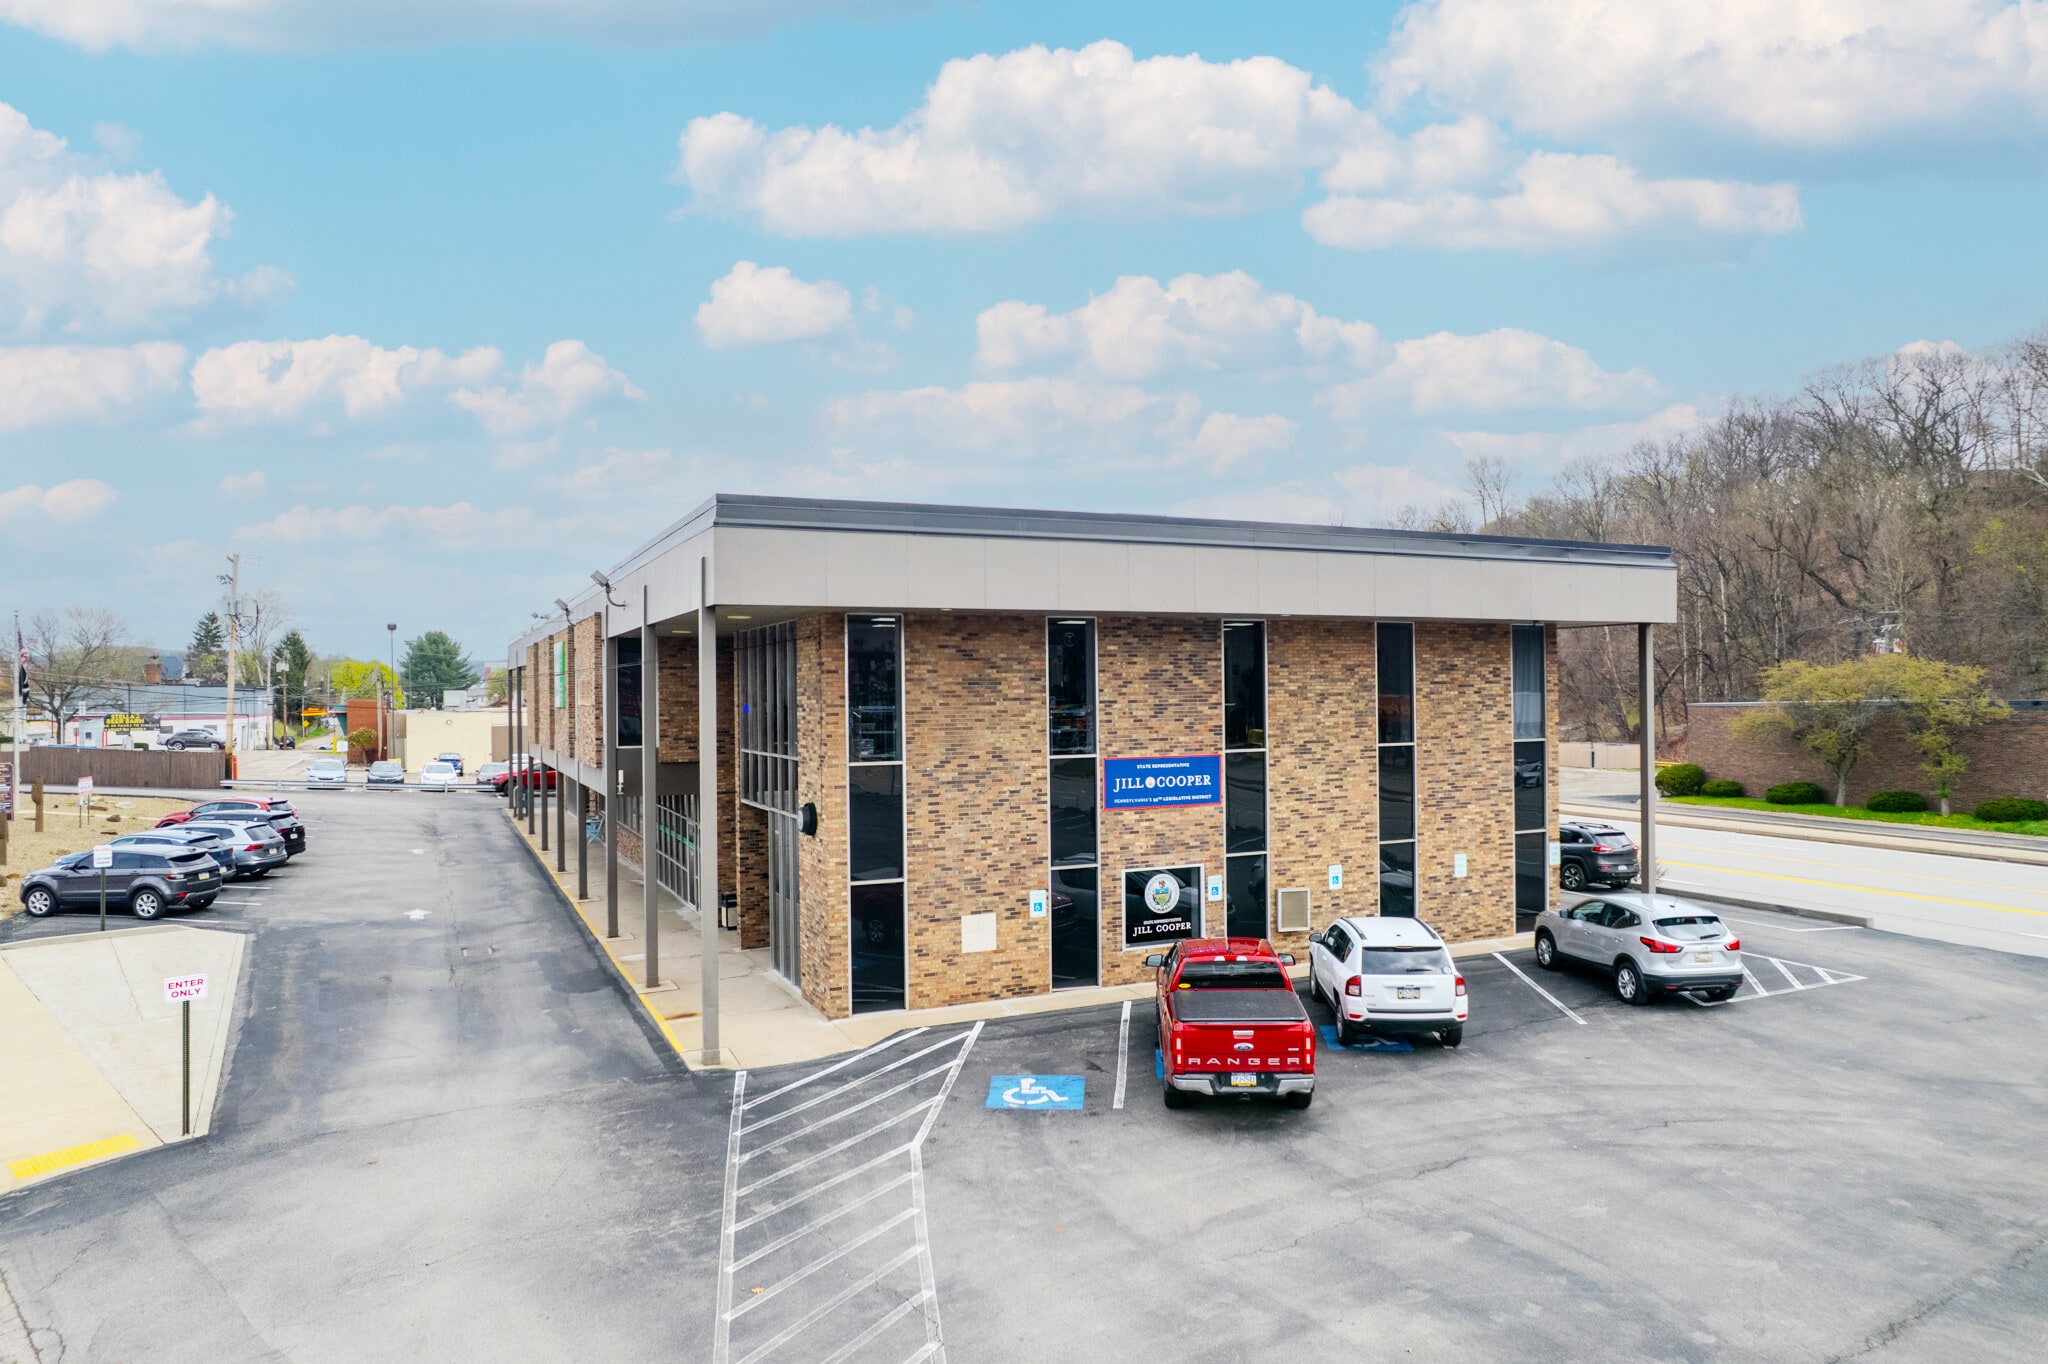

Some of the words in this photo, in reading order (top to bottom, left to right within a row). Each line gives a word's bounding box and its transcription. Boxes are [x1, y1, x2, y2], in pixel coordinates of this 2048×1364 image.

[1113, 777, 1144, 793] JILL
[1156, 775, 1212, 788] COOPER
[1133, 926, 1153, 936] JILL
[1156, 922, 1192, 932] COOPER
[168, 978, 204, 990] ENTER
[171, 988, 201, 998] ONLY
[1188, 1057, 1300, 1065] RANGER
